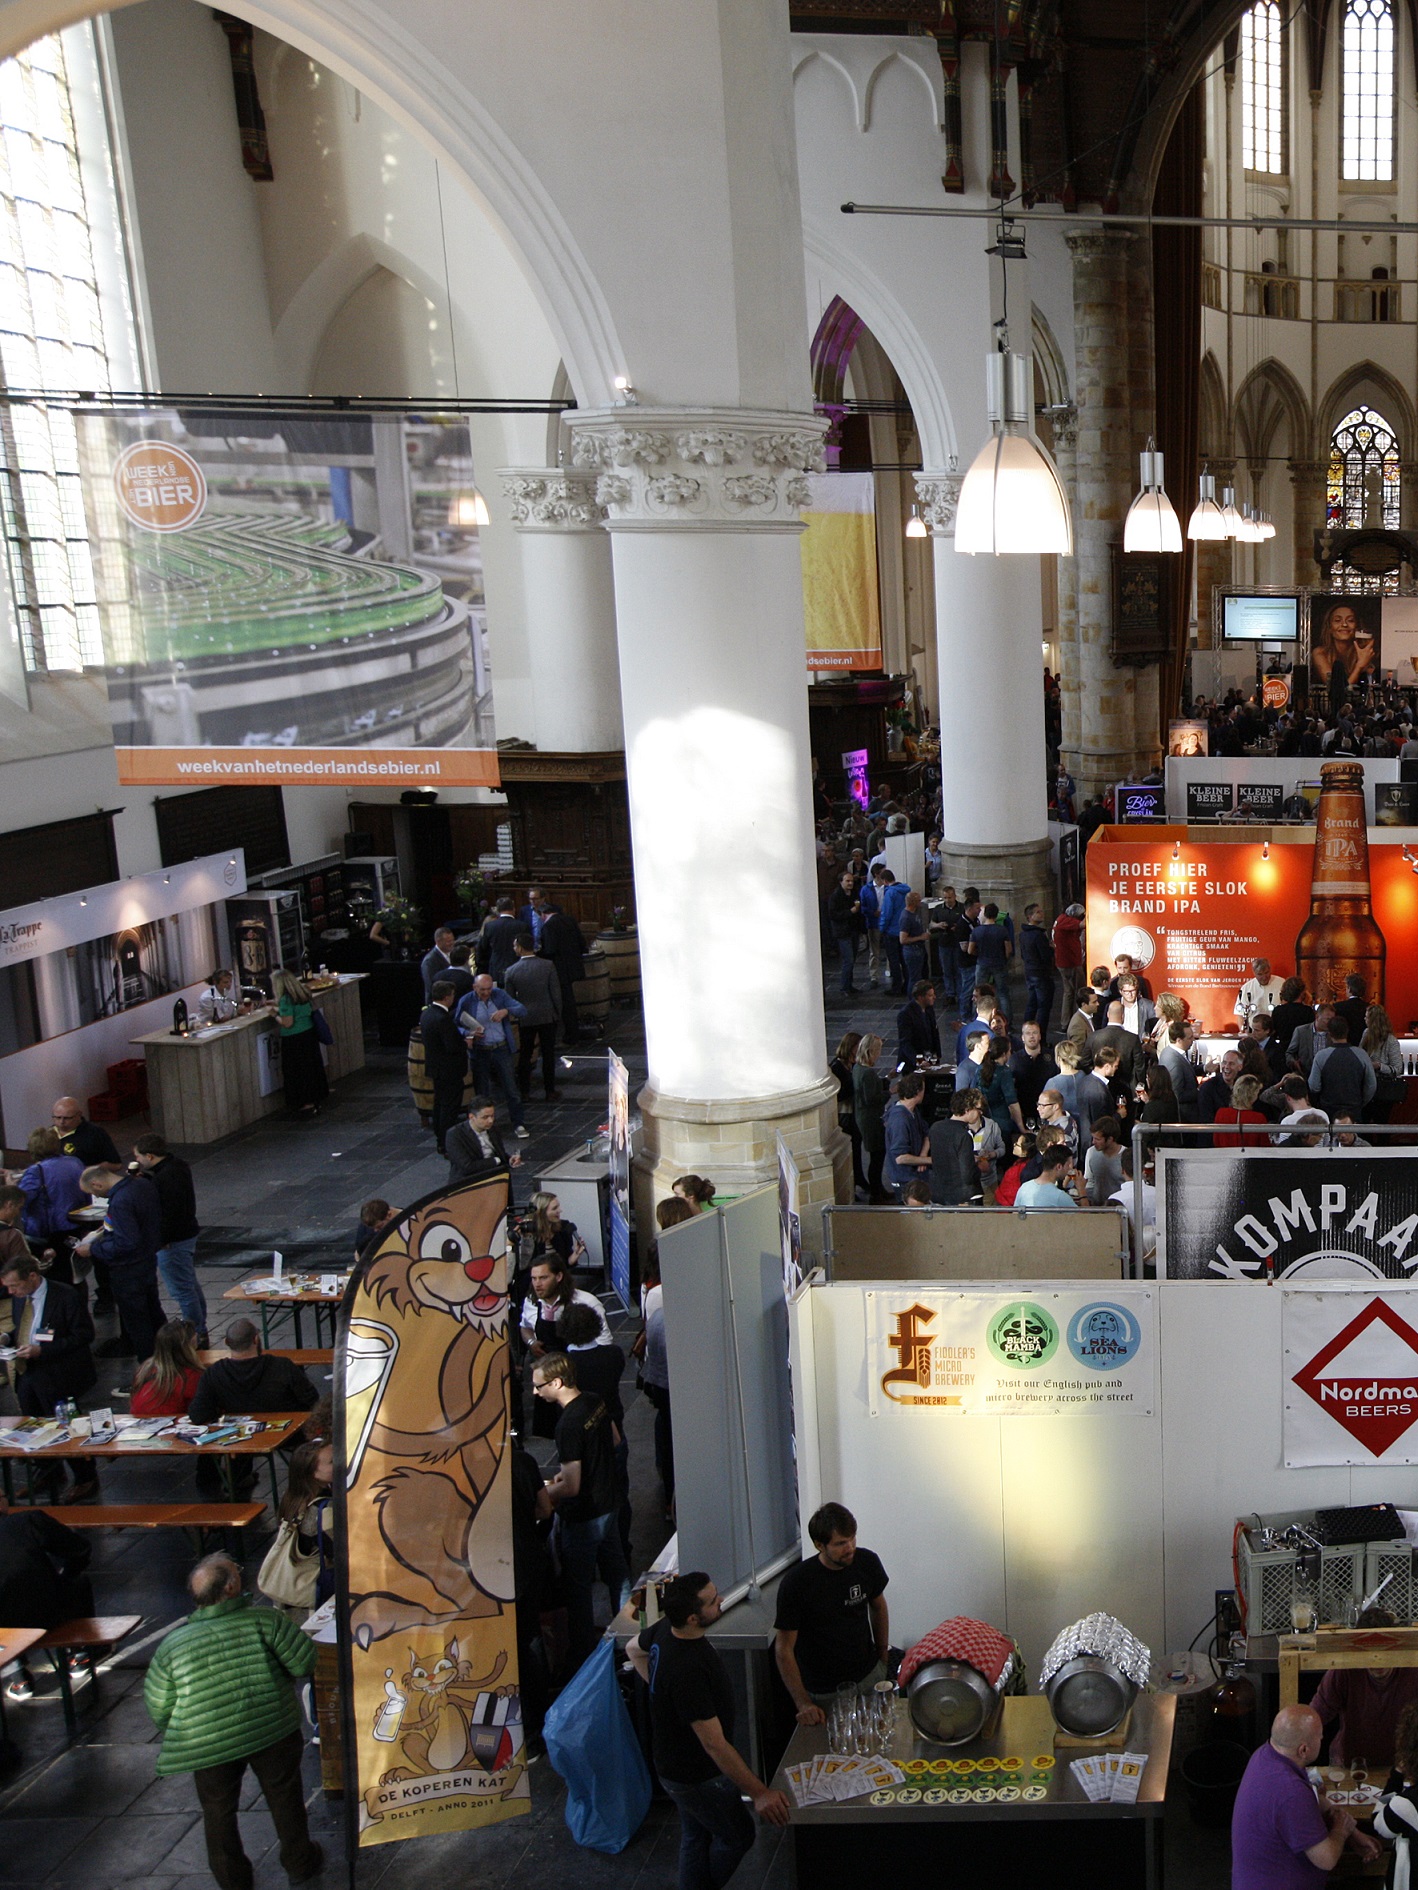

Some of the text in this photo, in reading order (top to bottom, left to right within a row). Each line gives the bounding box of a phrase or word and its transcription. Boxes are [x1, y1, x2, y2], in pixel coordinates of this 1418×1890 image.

[127, 465, 168, 478] WEEK
[135, 485, 196, 507] BIER
[177, 760, 441, 775] weekvanhetnederlandsebier.nl
[1189, 787, 1230, 795] KLEINE
[1239, 787, 1281, 797] KLEINE
[1196, 795, 1224, 803] BEER
[1324, 817, 1359, 829] Brand
[1108, 863, 1207, 876] PROEF HIER
[1109, 881, 1247, 895] JE EERSTE SLOK
[1109, 900, 1200, 913] BRAND IPA
[1006, 1336, 1040, 1344] BLACK
[1089, 1338, 1119, 1347] SEA
[935, 1347, 976, 1358] FIDDLER'S
[1004, 1344, 1042, 1352] MAMBA
[1081, 1346, 1128, 1355] LIONS
[935, 1361, 962, 1372] MICRO
[935, 1374, 976, 1386] BREWERY
[996, 1379, 1021, 1388] Visit
[1043, 1379, 1082, 1390] English
[1085, 1380, 1102, 1390] pub
[1105, 1379, 1123, 1388] and
[913, 1396, 932, 1405] SINCE
[986, 1393, 1134, 1403] micro brewery across the street
[1346, 1404, 1411, 1417] BEERS
[378, 1776, 508, 1804] DE KOPEREN KAT
[391, 1808, 426, 1820] DELFT
[437, 1801, 468, 1813] ANNO
[471, 1799, 494, 1808] 2011
